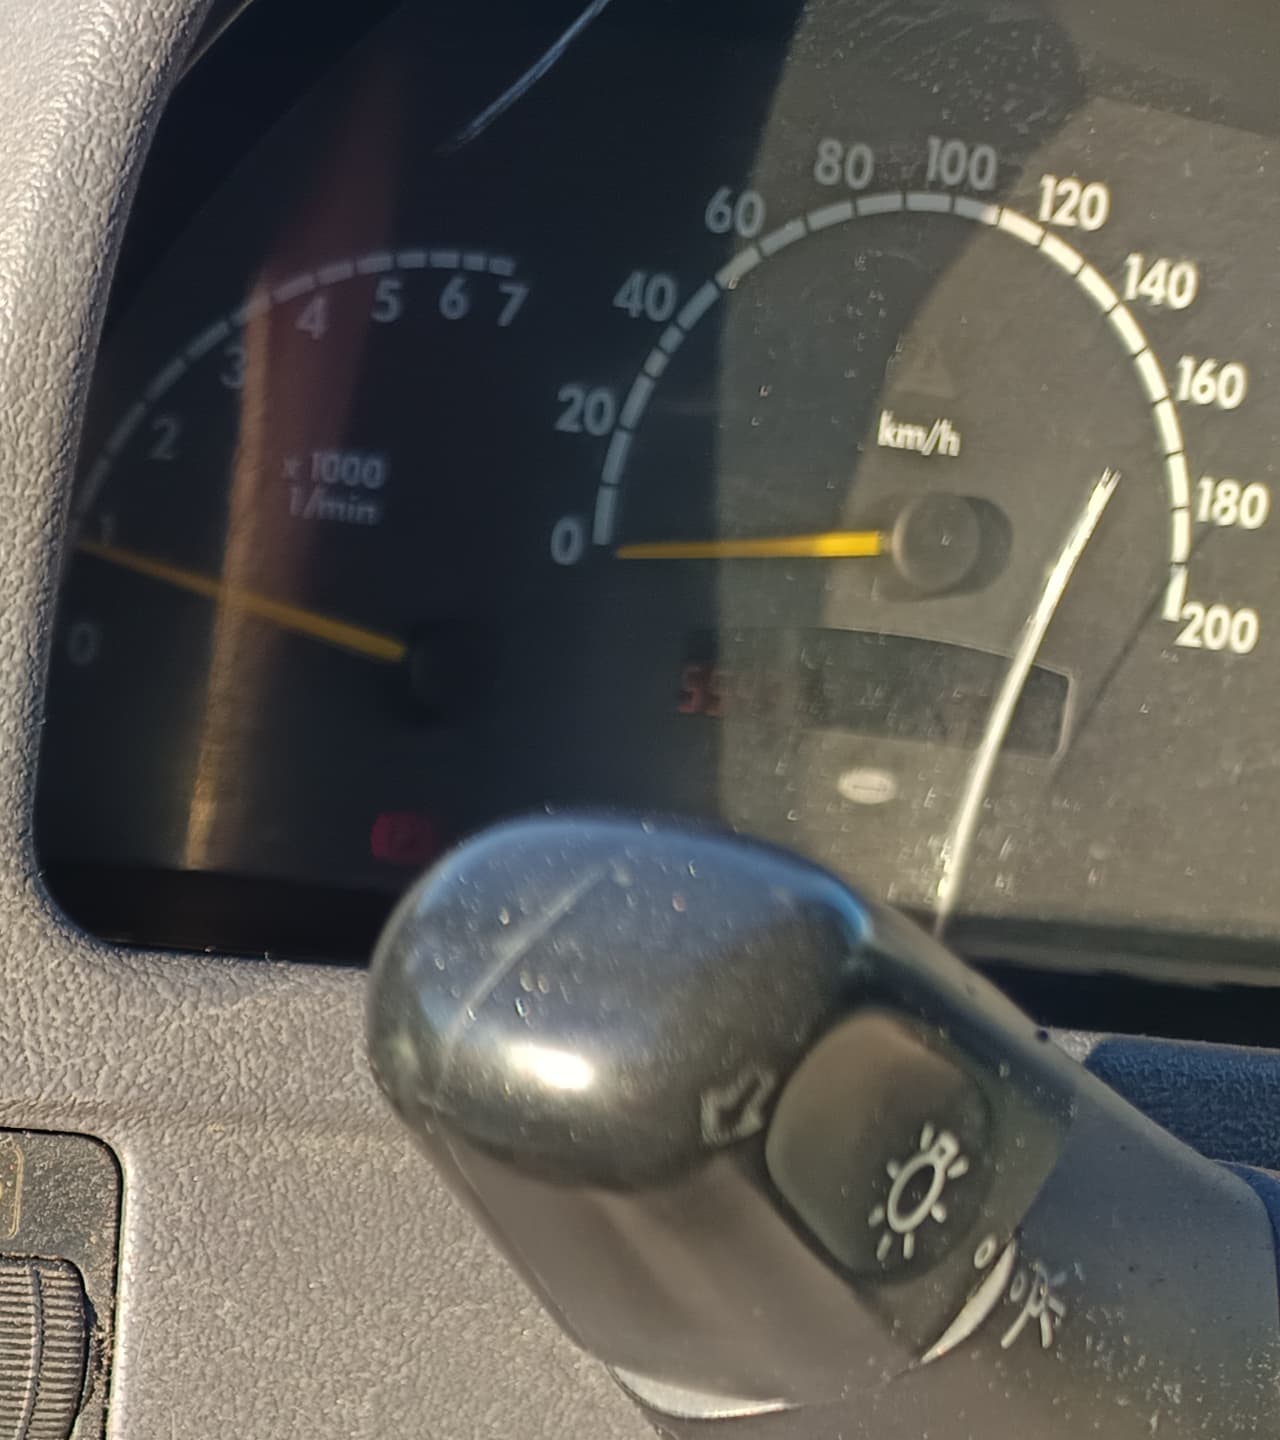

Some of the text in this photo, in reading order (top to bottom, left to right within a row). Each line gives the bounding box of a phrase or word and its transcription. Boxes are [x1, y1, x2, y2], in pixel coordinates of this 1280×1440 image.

[814, 139, 874, 189] 80
[924, 136, 997, 191] 100
[704, 187, 765, 240] 60
[1038, 175, 1110, 231] 120
[371, 278, 402, 322] 5
[439, 276, 470, 320] 6
[496, 282, 530, 327] 7
[613, 271, 678, 323] 40
[1123, 253, 1198, 309] 140
[296, 298, 328, 340] 4
[221, 346, 248, 387] 3
[1176, 357, 1247, 410] 160
[556, 384, 616, 437] 20
[877, 409, 960, 457] km/h
[149, 416, 182, 460] 2
[311, 451, 385, 489] 1000
[1196, 478, 1269, 529] 180
[550, 517, 584, 565] 0
[67, 621, 97, 666] 0
[1174, 607, 1260, 655] 200
